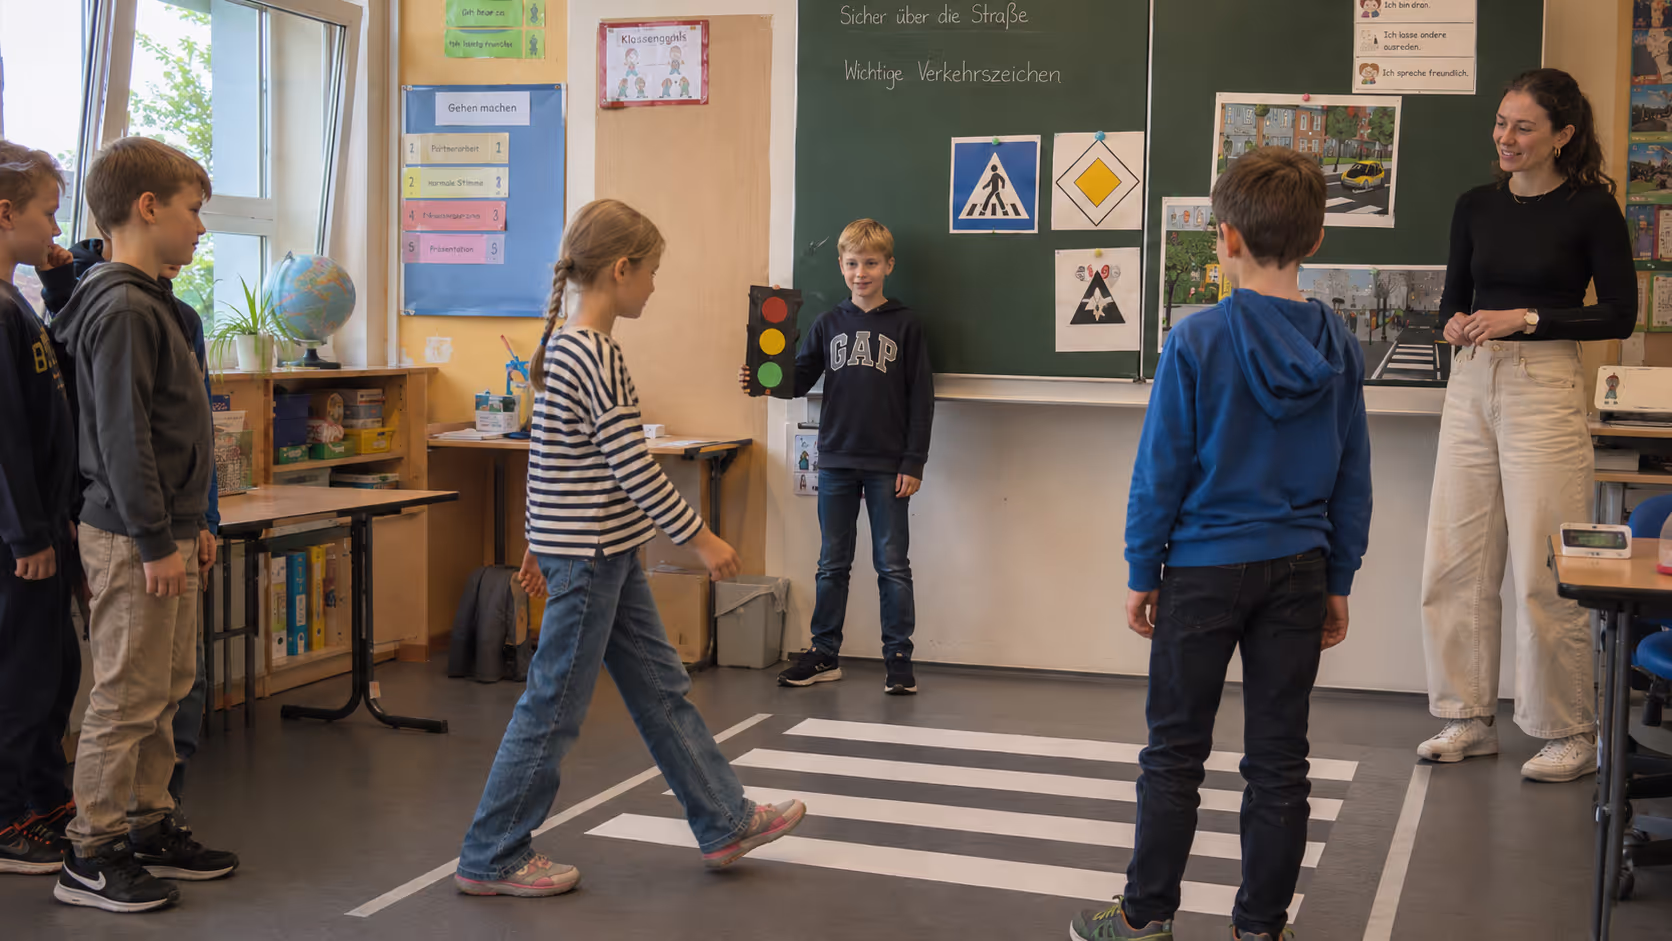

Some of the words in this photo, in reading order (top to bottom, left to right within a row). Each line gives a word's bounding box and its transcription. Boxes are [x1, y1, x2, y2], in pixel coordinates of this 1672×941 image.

[840, 5, 887, 25] Sicher
[896, 5, 930, 24] über
[937, 3, 961, 24] die
[971, 1, 1029, 30] Straße
[844, 59, 904, 90] Wichtige
[917, 60, 1062, 84] Verkehrszeichen
[448, 103, 478, 113] Gehen
[480, 103, 517, 113] machen
[829, 330, 898, 374] GAP
